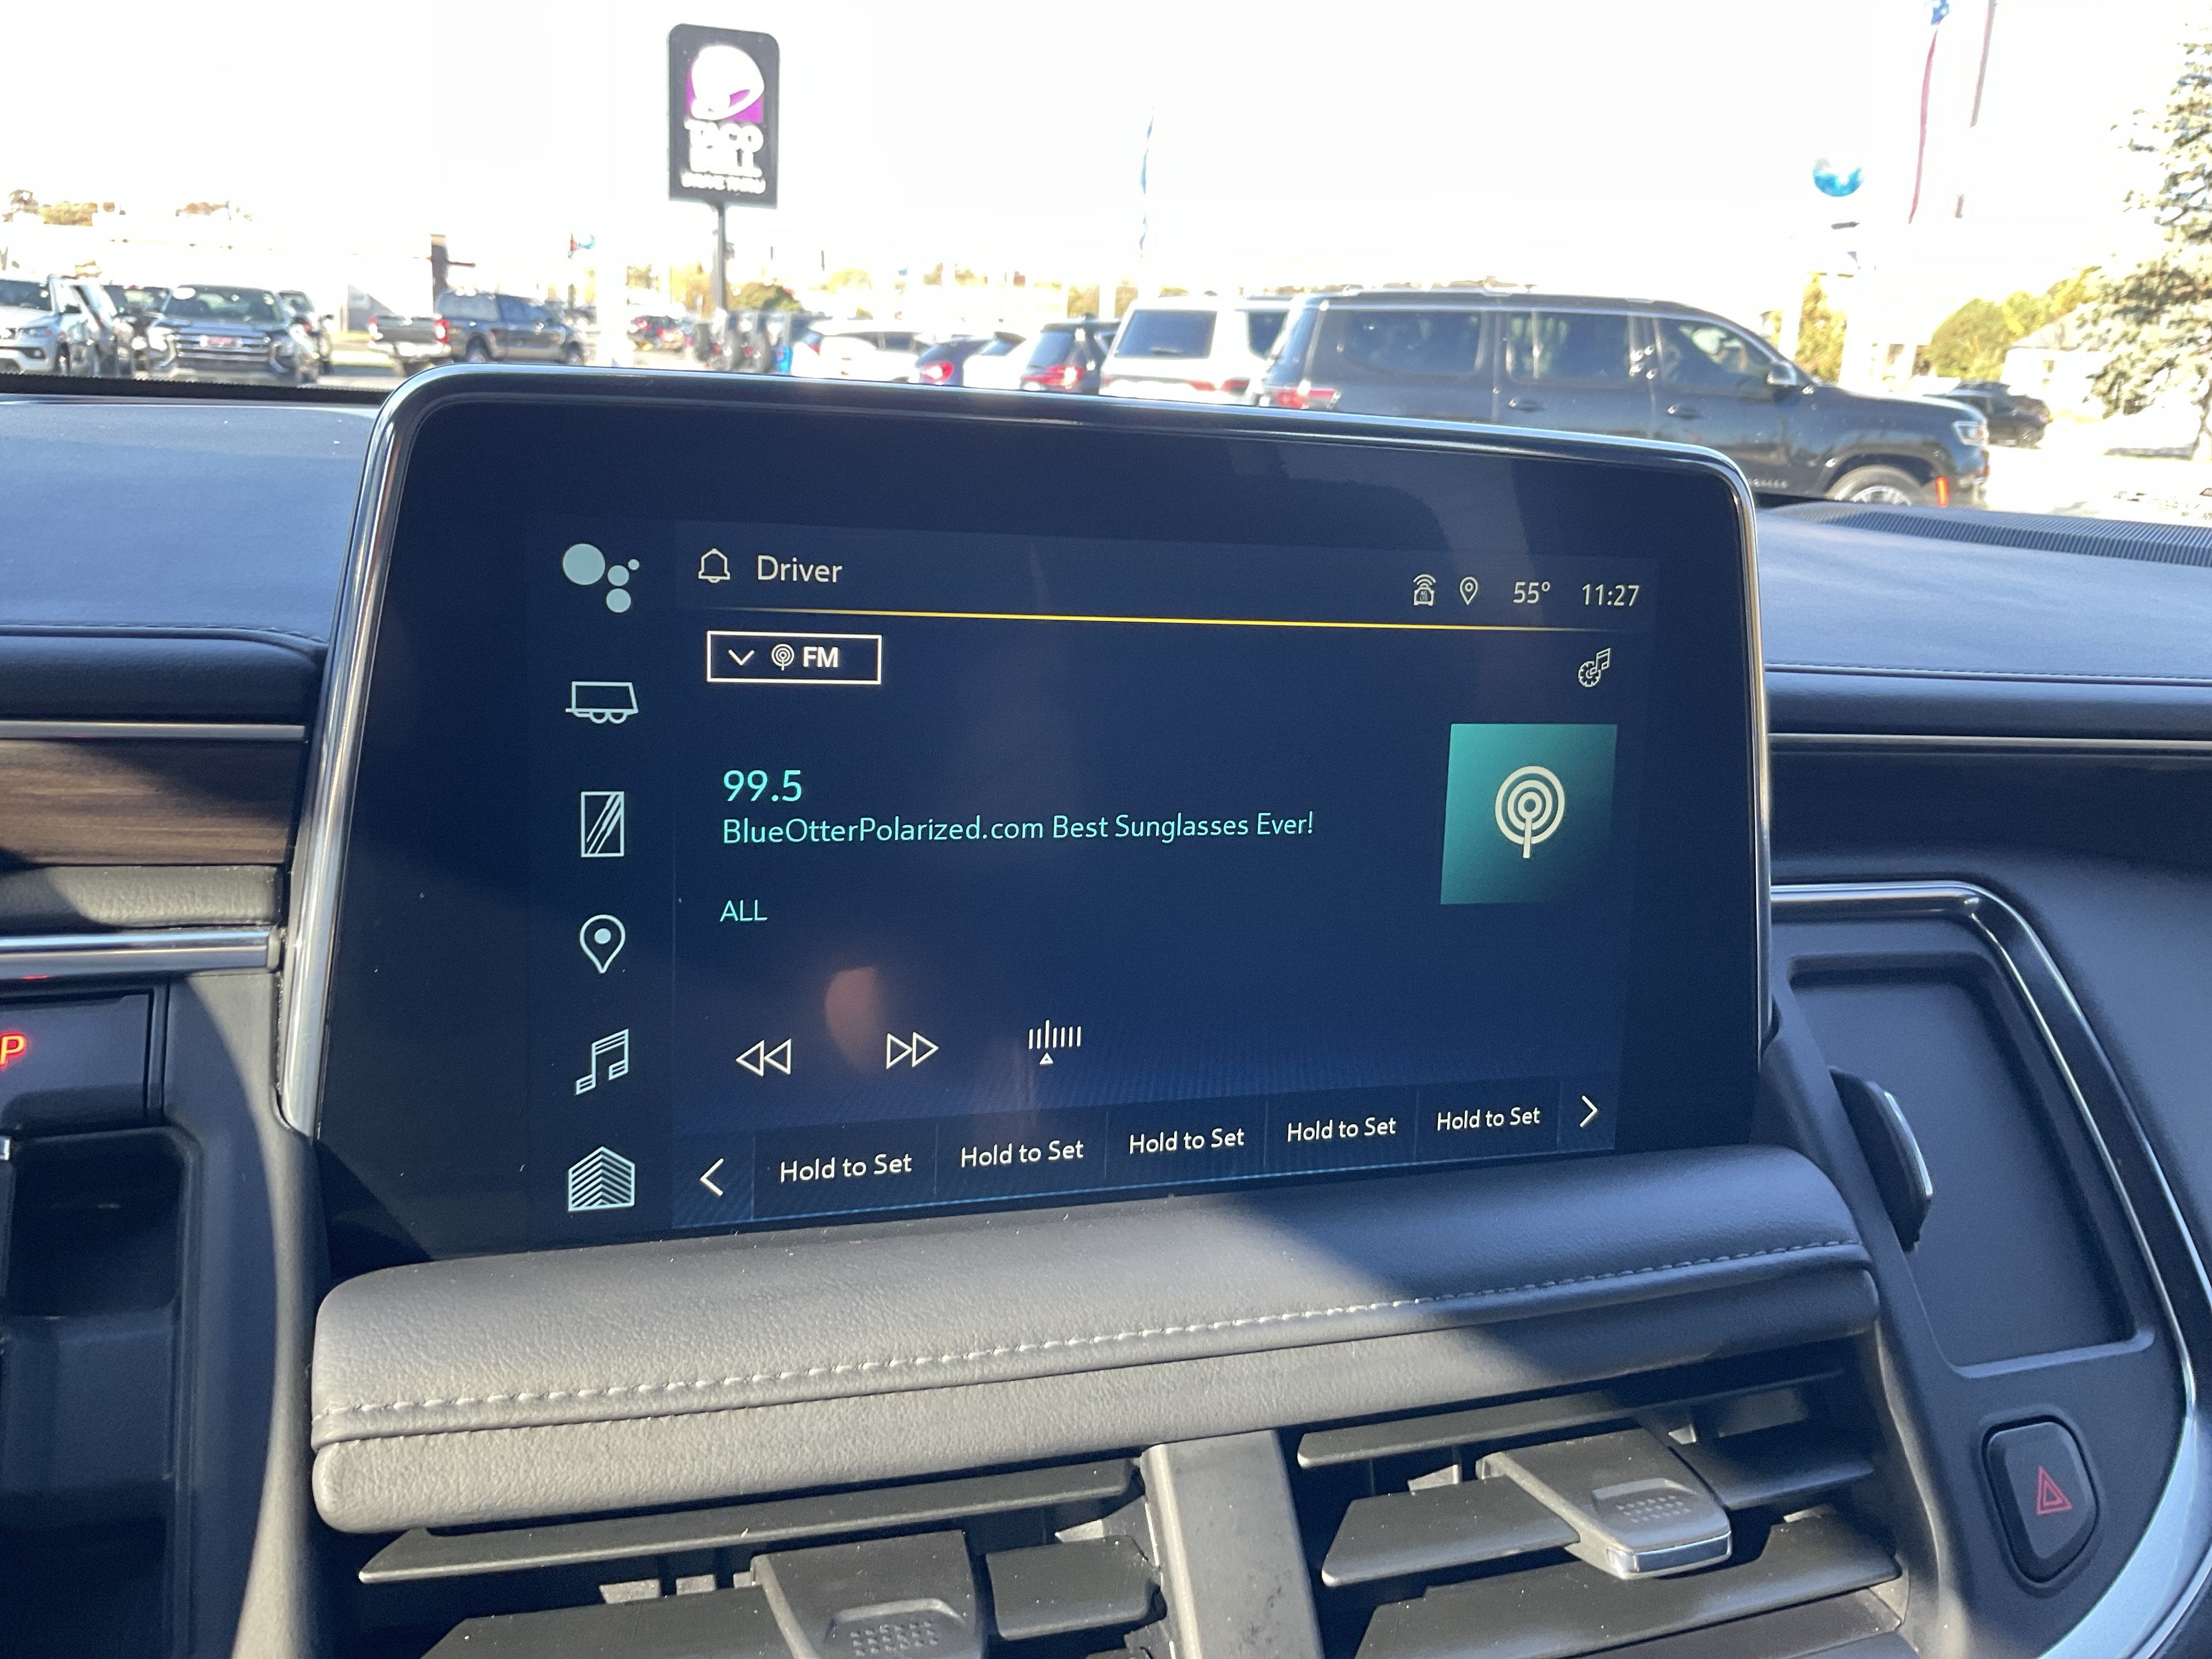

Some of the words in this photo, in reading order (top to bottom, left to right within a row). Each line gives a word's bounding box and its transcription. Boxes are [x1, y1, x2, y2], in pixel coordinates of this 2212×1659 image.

[757, 554, 843, 583] Driver
[1582, 583, 1640, 607] 11:27
[803, 645, 839, 668] FM
[723, 769, 803, 803] 99.5
[723, 814, 1044, 844] BlueOtterPolarized.com
[1052, 814, 1109, 839] Best
[1114, 811, 1249, 844] Sunglasses
[1256, 810, 1313, 837] Ever!
[719, 899, 769, 923] ALL
[1287, 1119, 1334, 1143] Hold
[1338, 1120, 1359, 1138] to
[1363, 1116, 1397, 1137] Set
[1436, 1108, 1481, 1132] Hold
[1485, 1110, 1505, 1128] to
[1509, 1106, 1541, 1126] Set
[961, 1142, 1013, 1169] Hold
[1018, 1143, 1042, 1164] to
[1047, 1139, 1084, 1161] Set
[1128, 1130, 1178, 1155] Hold
[1183, 1131, 1205, 1150] to
[1210, 1127, 1245, 1149] Set
[780, 1156, 836, 1183] Hold
[842, 1158, 867, 1178] to
[873, 1153, 913, 1176] Set
